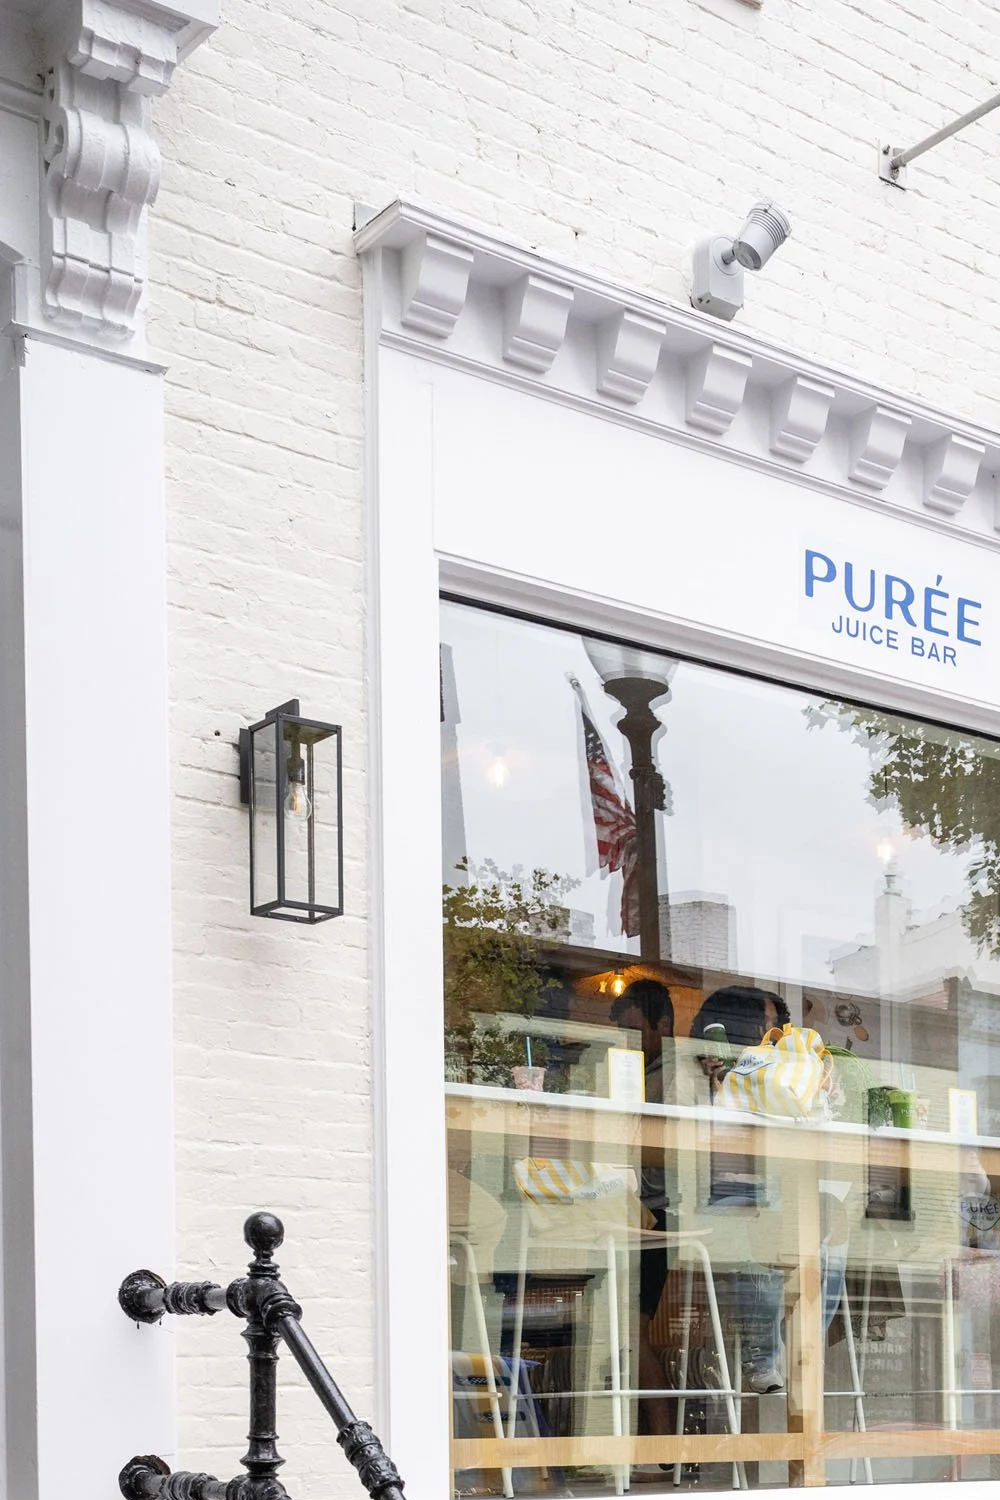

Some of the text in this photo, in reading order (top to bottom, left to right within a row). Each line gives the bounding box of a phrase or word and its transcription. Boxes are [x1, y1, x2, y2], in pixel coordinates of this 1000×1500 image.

[805, 549, 981, 646] PURÉE
[832, 615, 956, 666] JUICE BAR
